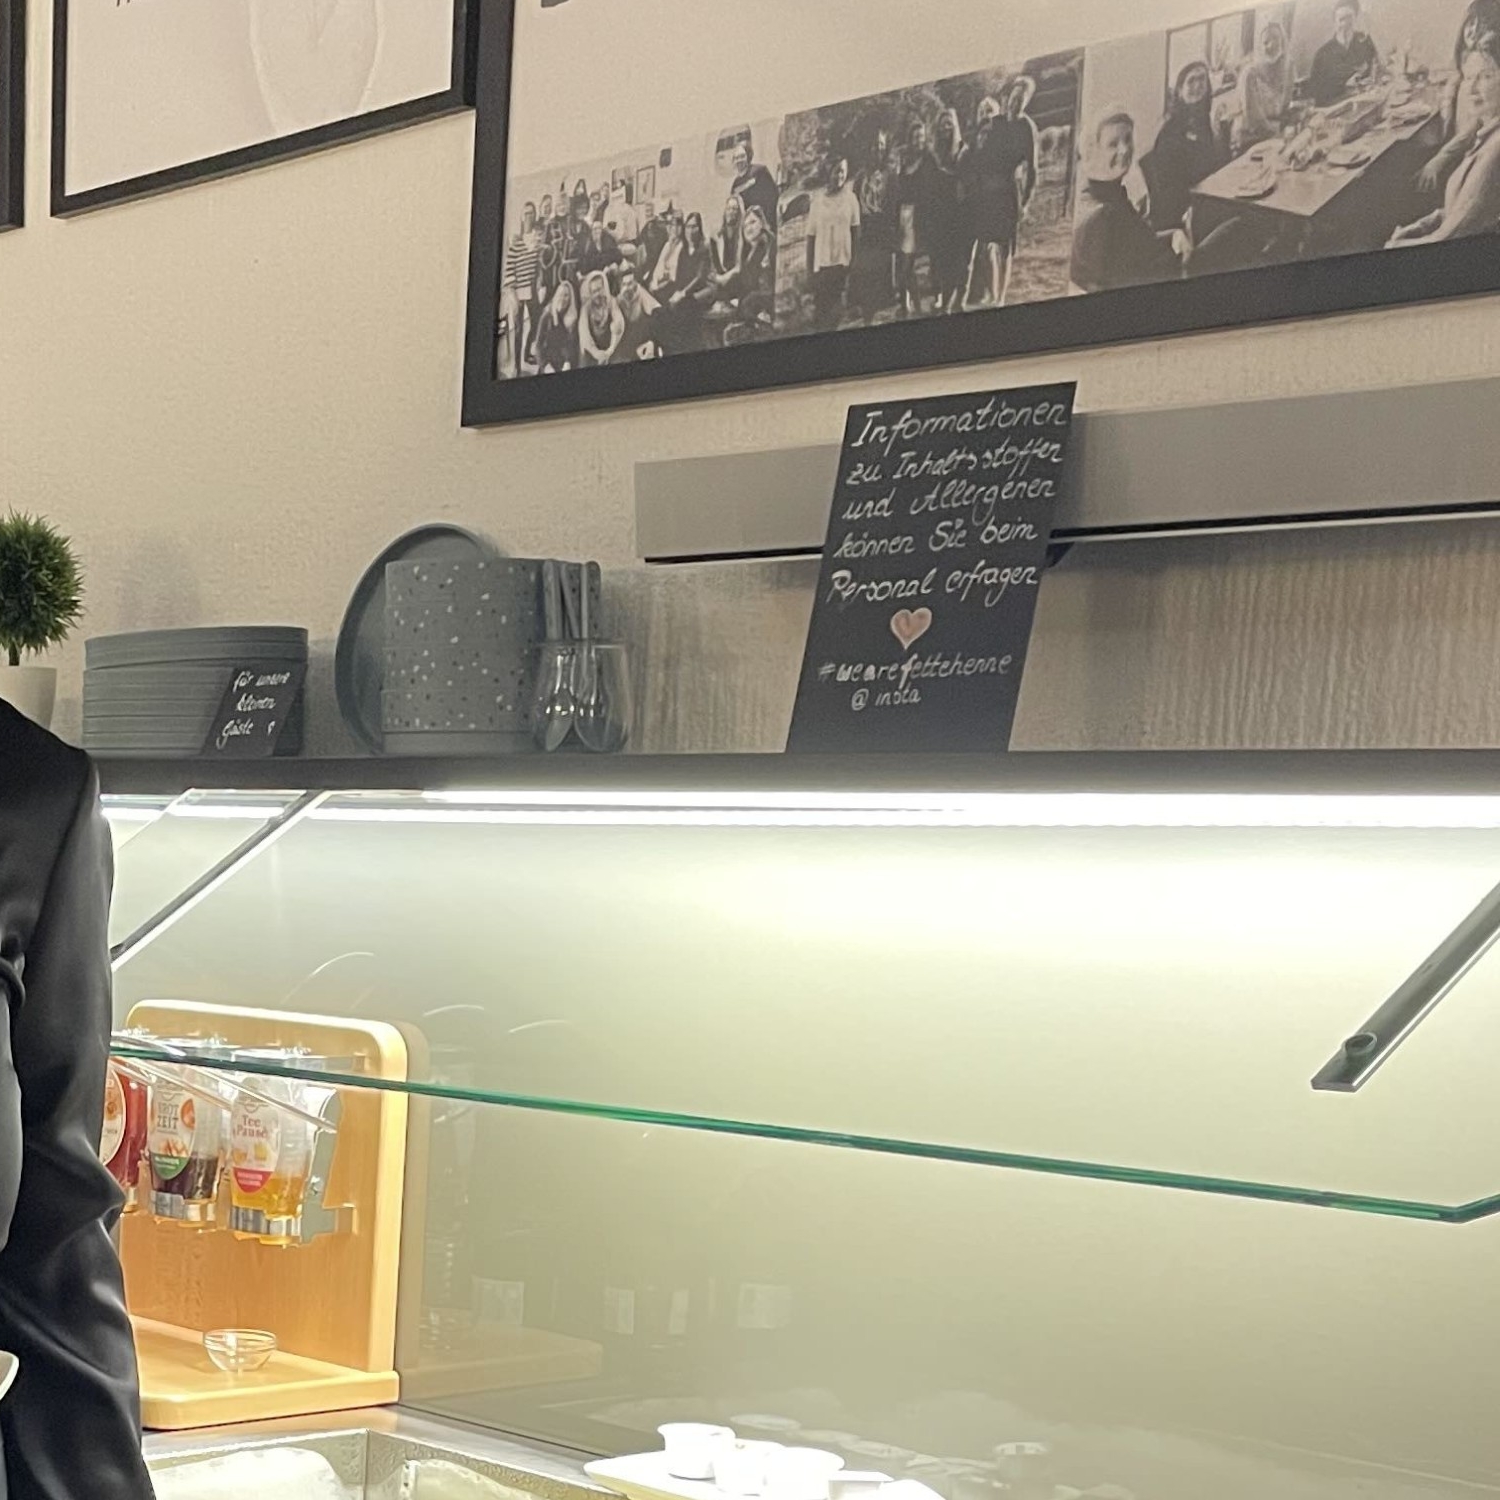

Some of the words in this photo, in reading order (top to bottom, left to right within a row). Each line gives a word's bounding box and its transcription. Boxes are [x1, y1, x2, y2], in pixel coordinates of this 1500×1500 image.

[851, 397, 1067, 455] Informationen
[846, 463, 883, 485] zu
[893, 436, 1063, 480] Inhaltsstoffen
[842, 487, 897, 520] und
[910, 478, 1056, 527] Allergenen
[834, 530, 915, 558] können
[929, 518, 966, 552] Sie
[980, 516, 1038, 544] beim
[826, 568, 938, 603] Personal
[945, 560, 1038, 607] erfragen
[818, 653, 1012, 690] #wearefettehenne
[851, 688, 869, 711] @
[157, 1115, 179, 1129] ZEIT
[242, 1114, 261, 1127] Tee
